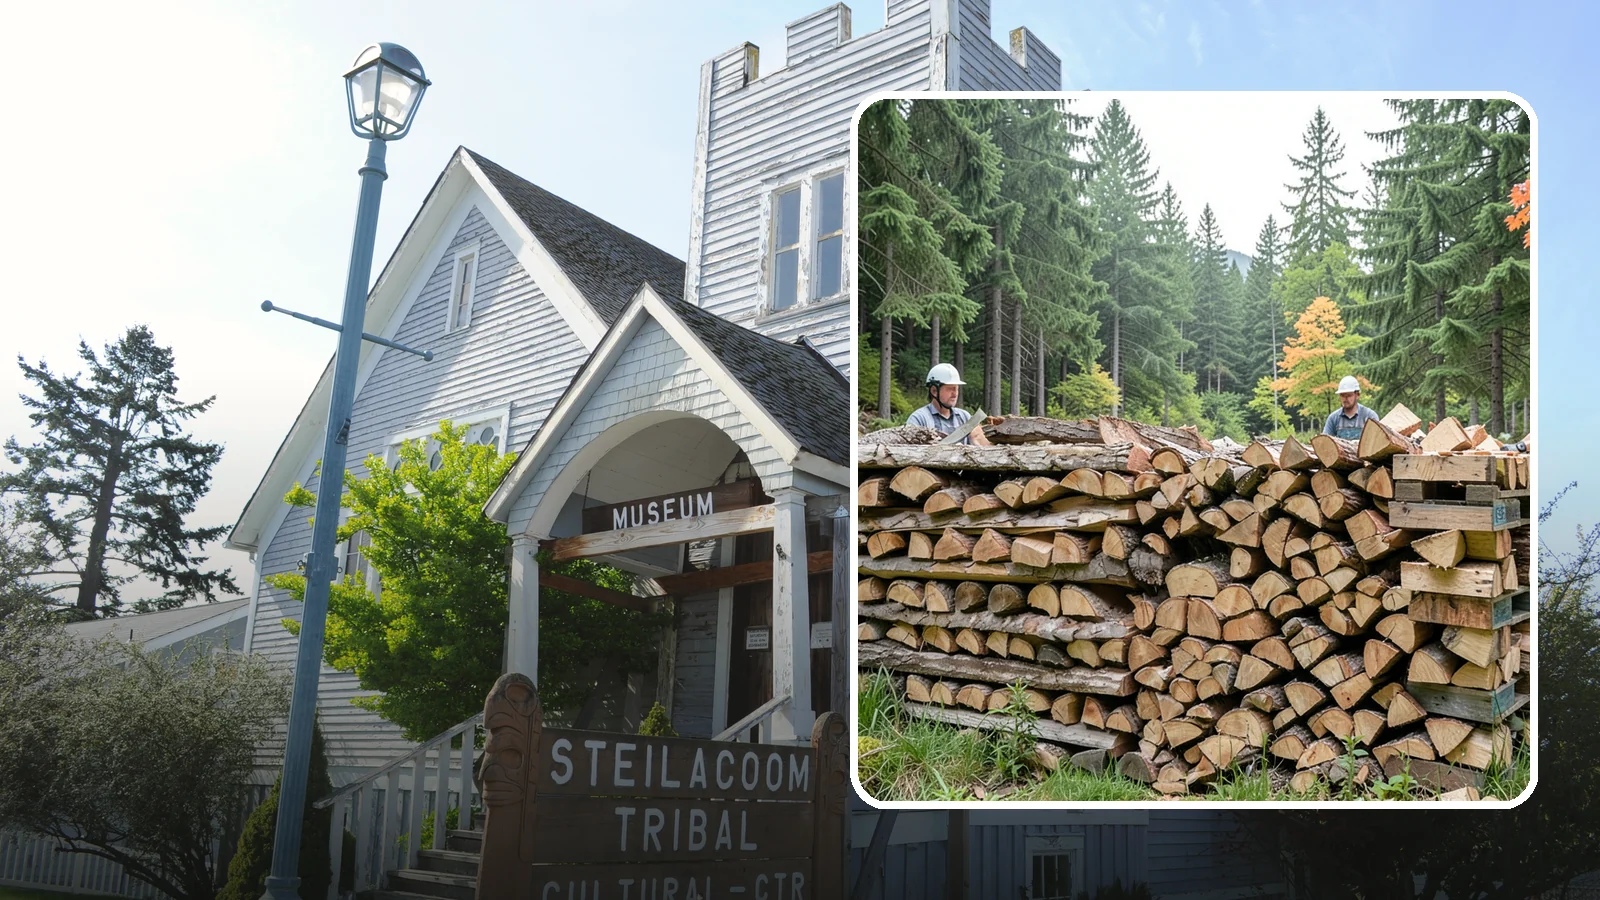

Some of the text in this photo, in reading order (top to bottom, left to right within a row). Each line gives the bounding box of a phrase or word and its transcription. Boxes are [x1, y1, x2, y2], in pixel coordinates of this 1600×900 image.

[612, 491, 714, 531] MUSEUM
[550, 738, 810, 793] STEILACOOM
[615, 806, 758, 852] TRIBAL
